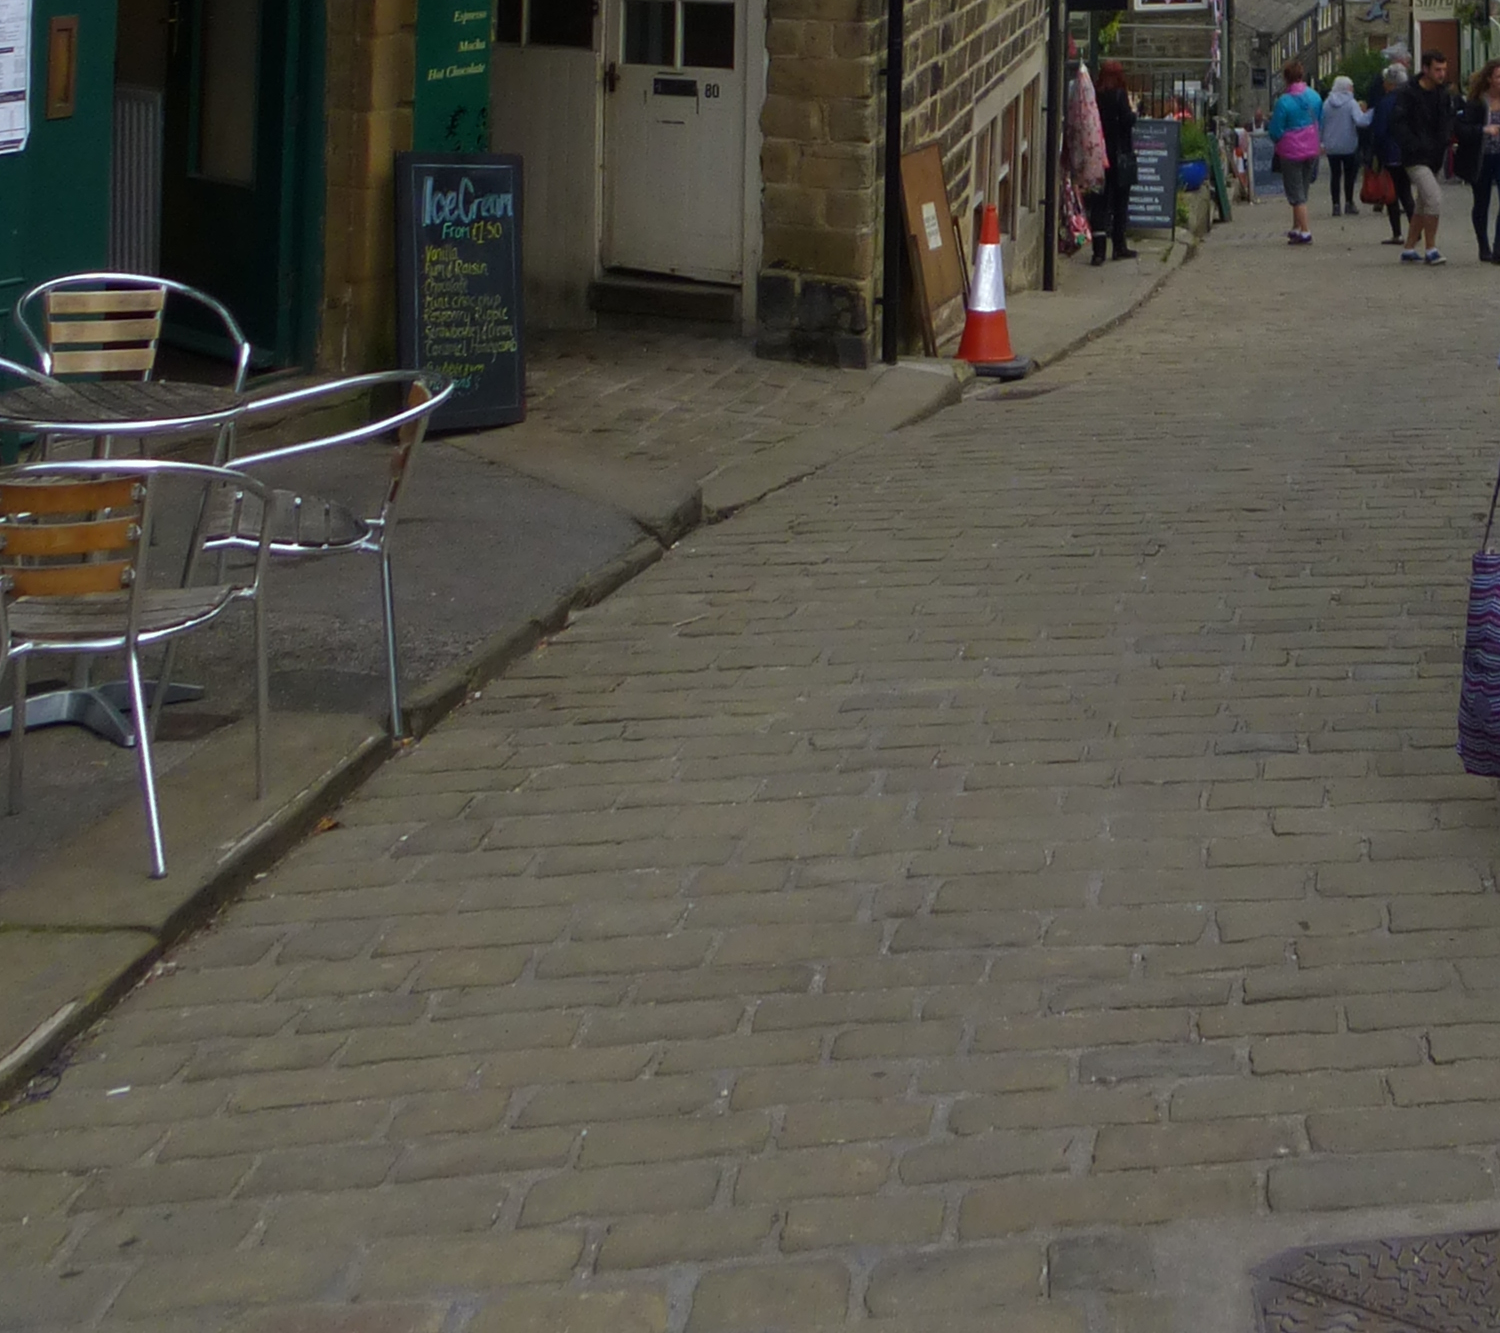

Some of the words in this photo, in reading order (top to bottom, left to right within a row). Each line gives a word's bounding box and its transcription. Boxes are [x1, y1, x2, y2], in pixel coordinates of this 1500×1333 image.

[453, 10, 487, 24] Espresso
[457, 37, 486, 53] Mocha
[427, 68, 444, 81] Hot
[446, 62, 486, 78] Chocolate
[705, 83, 720, 99] 80
[441, 221, 470, 240] From
[425, 244, 459, 263] Vanilla
[455, 259, 488, 276] Raisin
